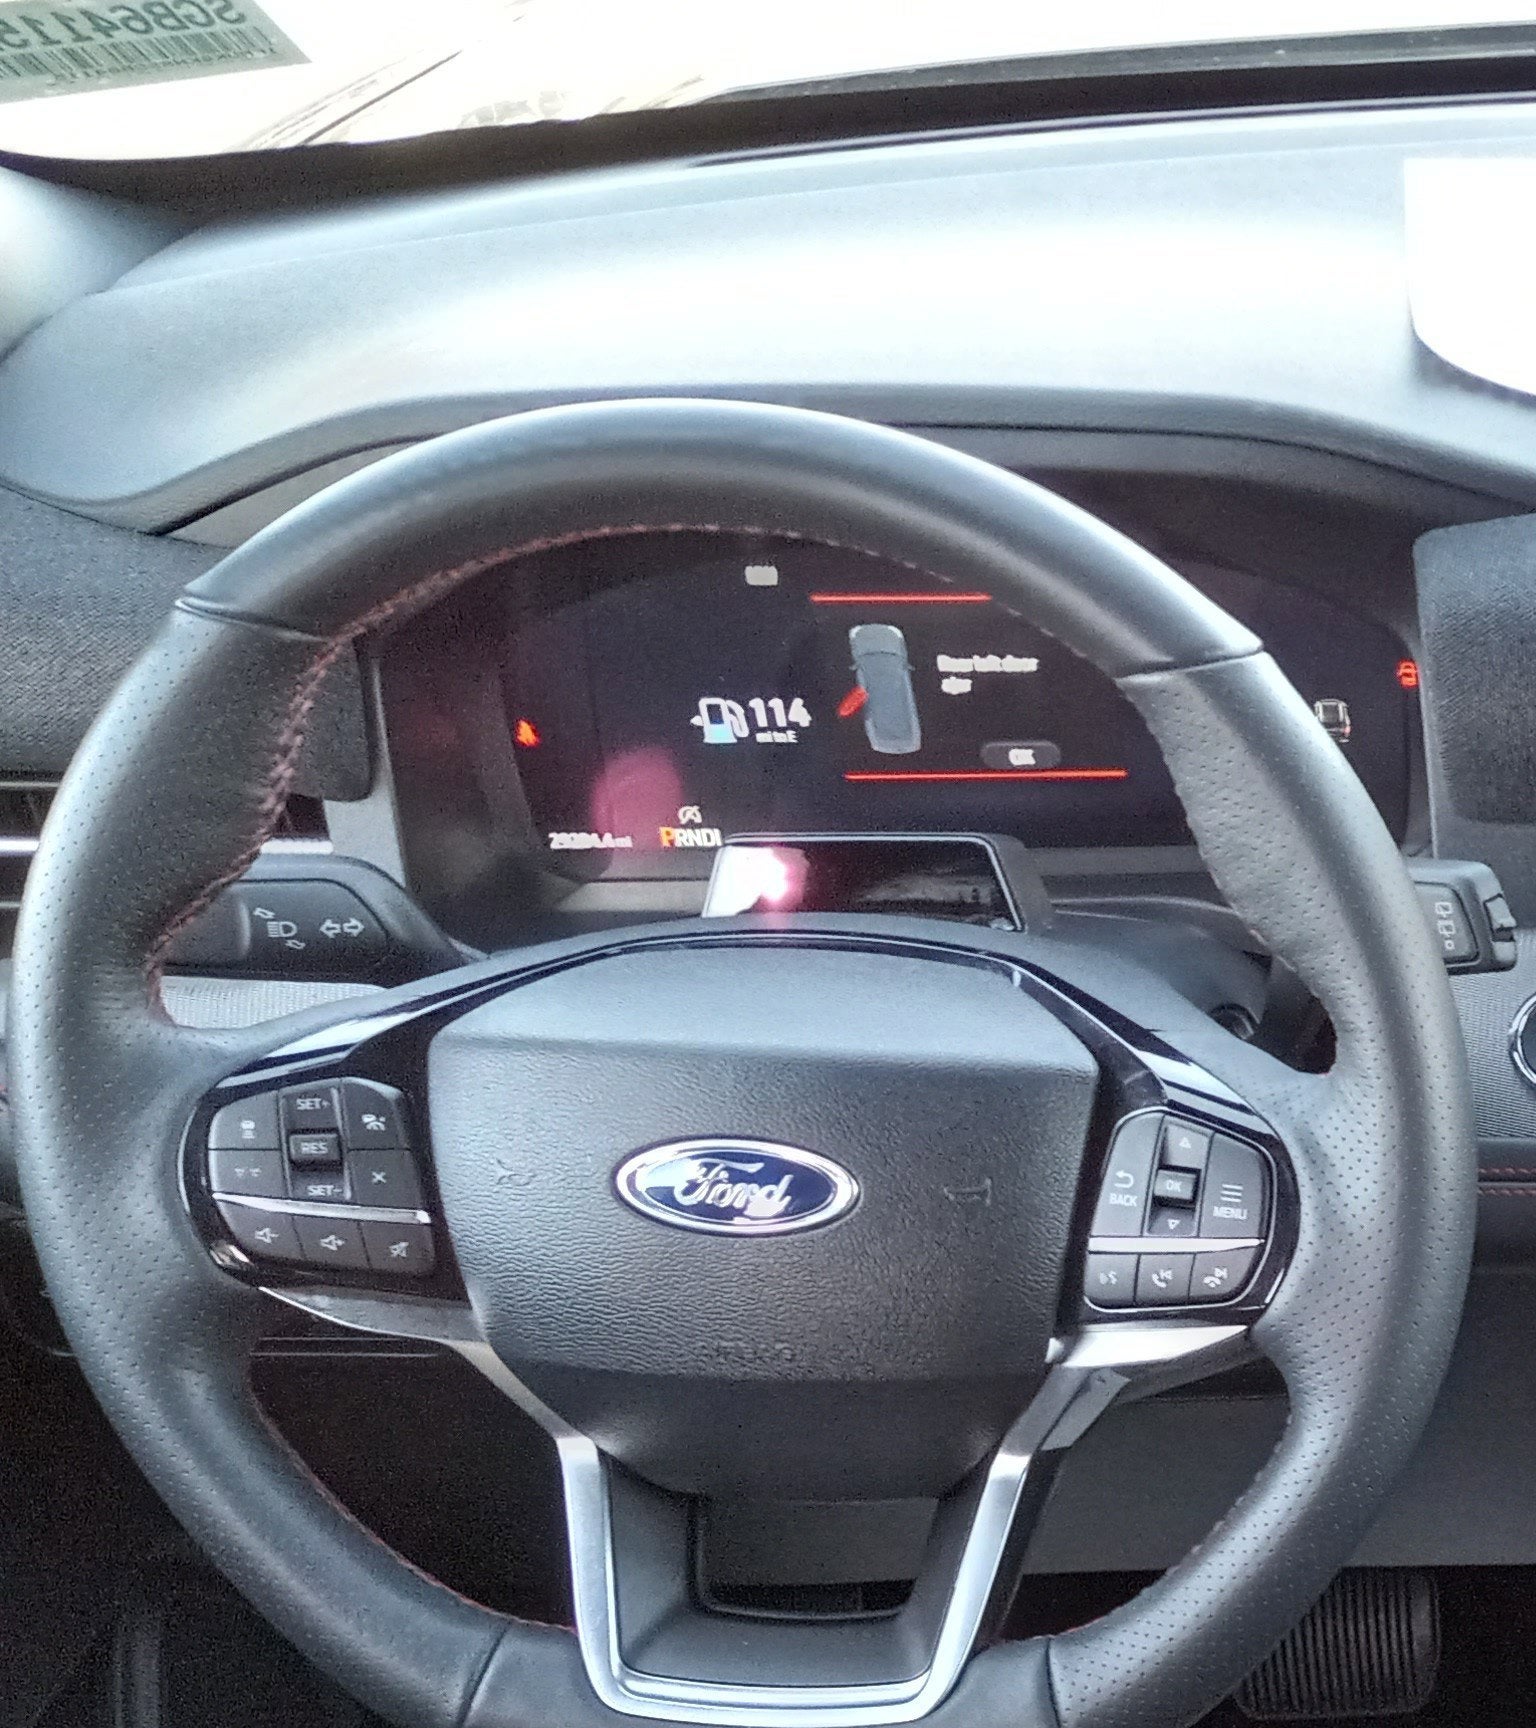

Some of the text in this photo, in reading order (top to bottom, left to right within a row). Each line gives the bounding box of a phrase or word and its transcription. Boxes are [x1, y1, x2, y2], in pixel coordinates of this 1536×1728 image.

[748, 697, 812, 727] 114
[301, 1142, 329, 1154] RES
[672, 1157, 795, 1210] Ford
[1166, 1180, 1181, 1192] OK
[1109, 1193, 1138, 1207] BACK
[1212, 1206, 1248, 1220] MENU
